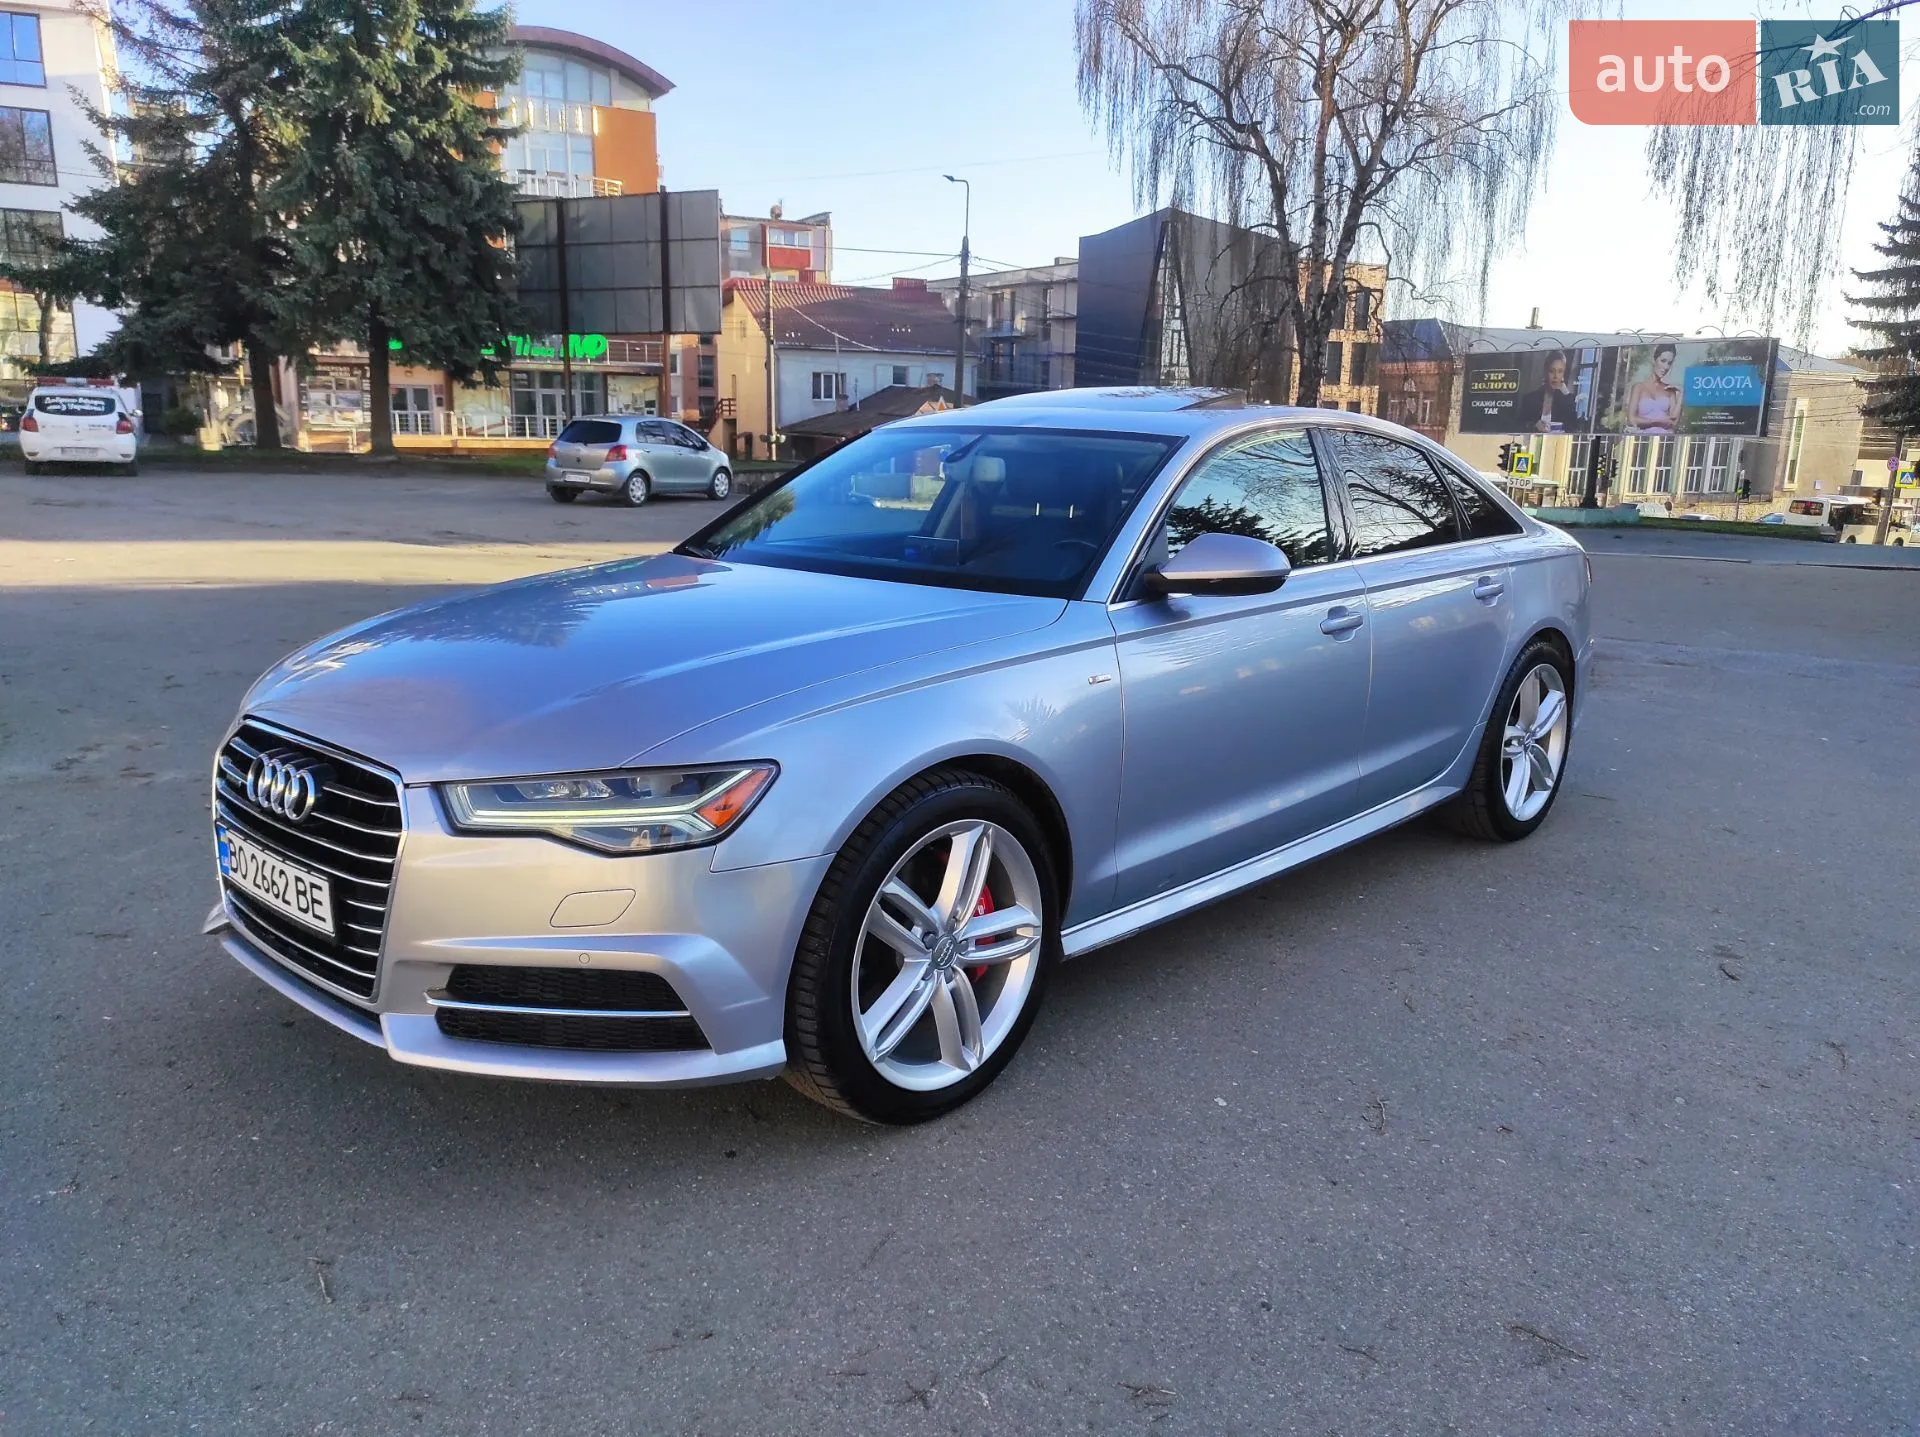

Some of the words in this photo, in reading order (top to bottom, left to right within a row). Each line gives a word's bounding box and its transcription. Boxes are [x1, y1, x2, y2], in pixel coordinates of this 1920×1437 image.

[1483, 373, 1505, 381] УКР
[1471, 381, 1517, 390] ЗОЛОТО
[1692, 375, 1753, 389] ЗОЛОТА
[1483, 407, 1499, 415] ТАК
[1509, 478, 1531, 487] STOP
[250, 852, 292, 907] 2662
[294, 875, 327, 923] BE
